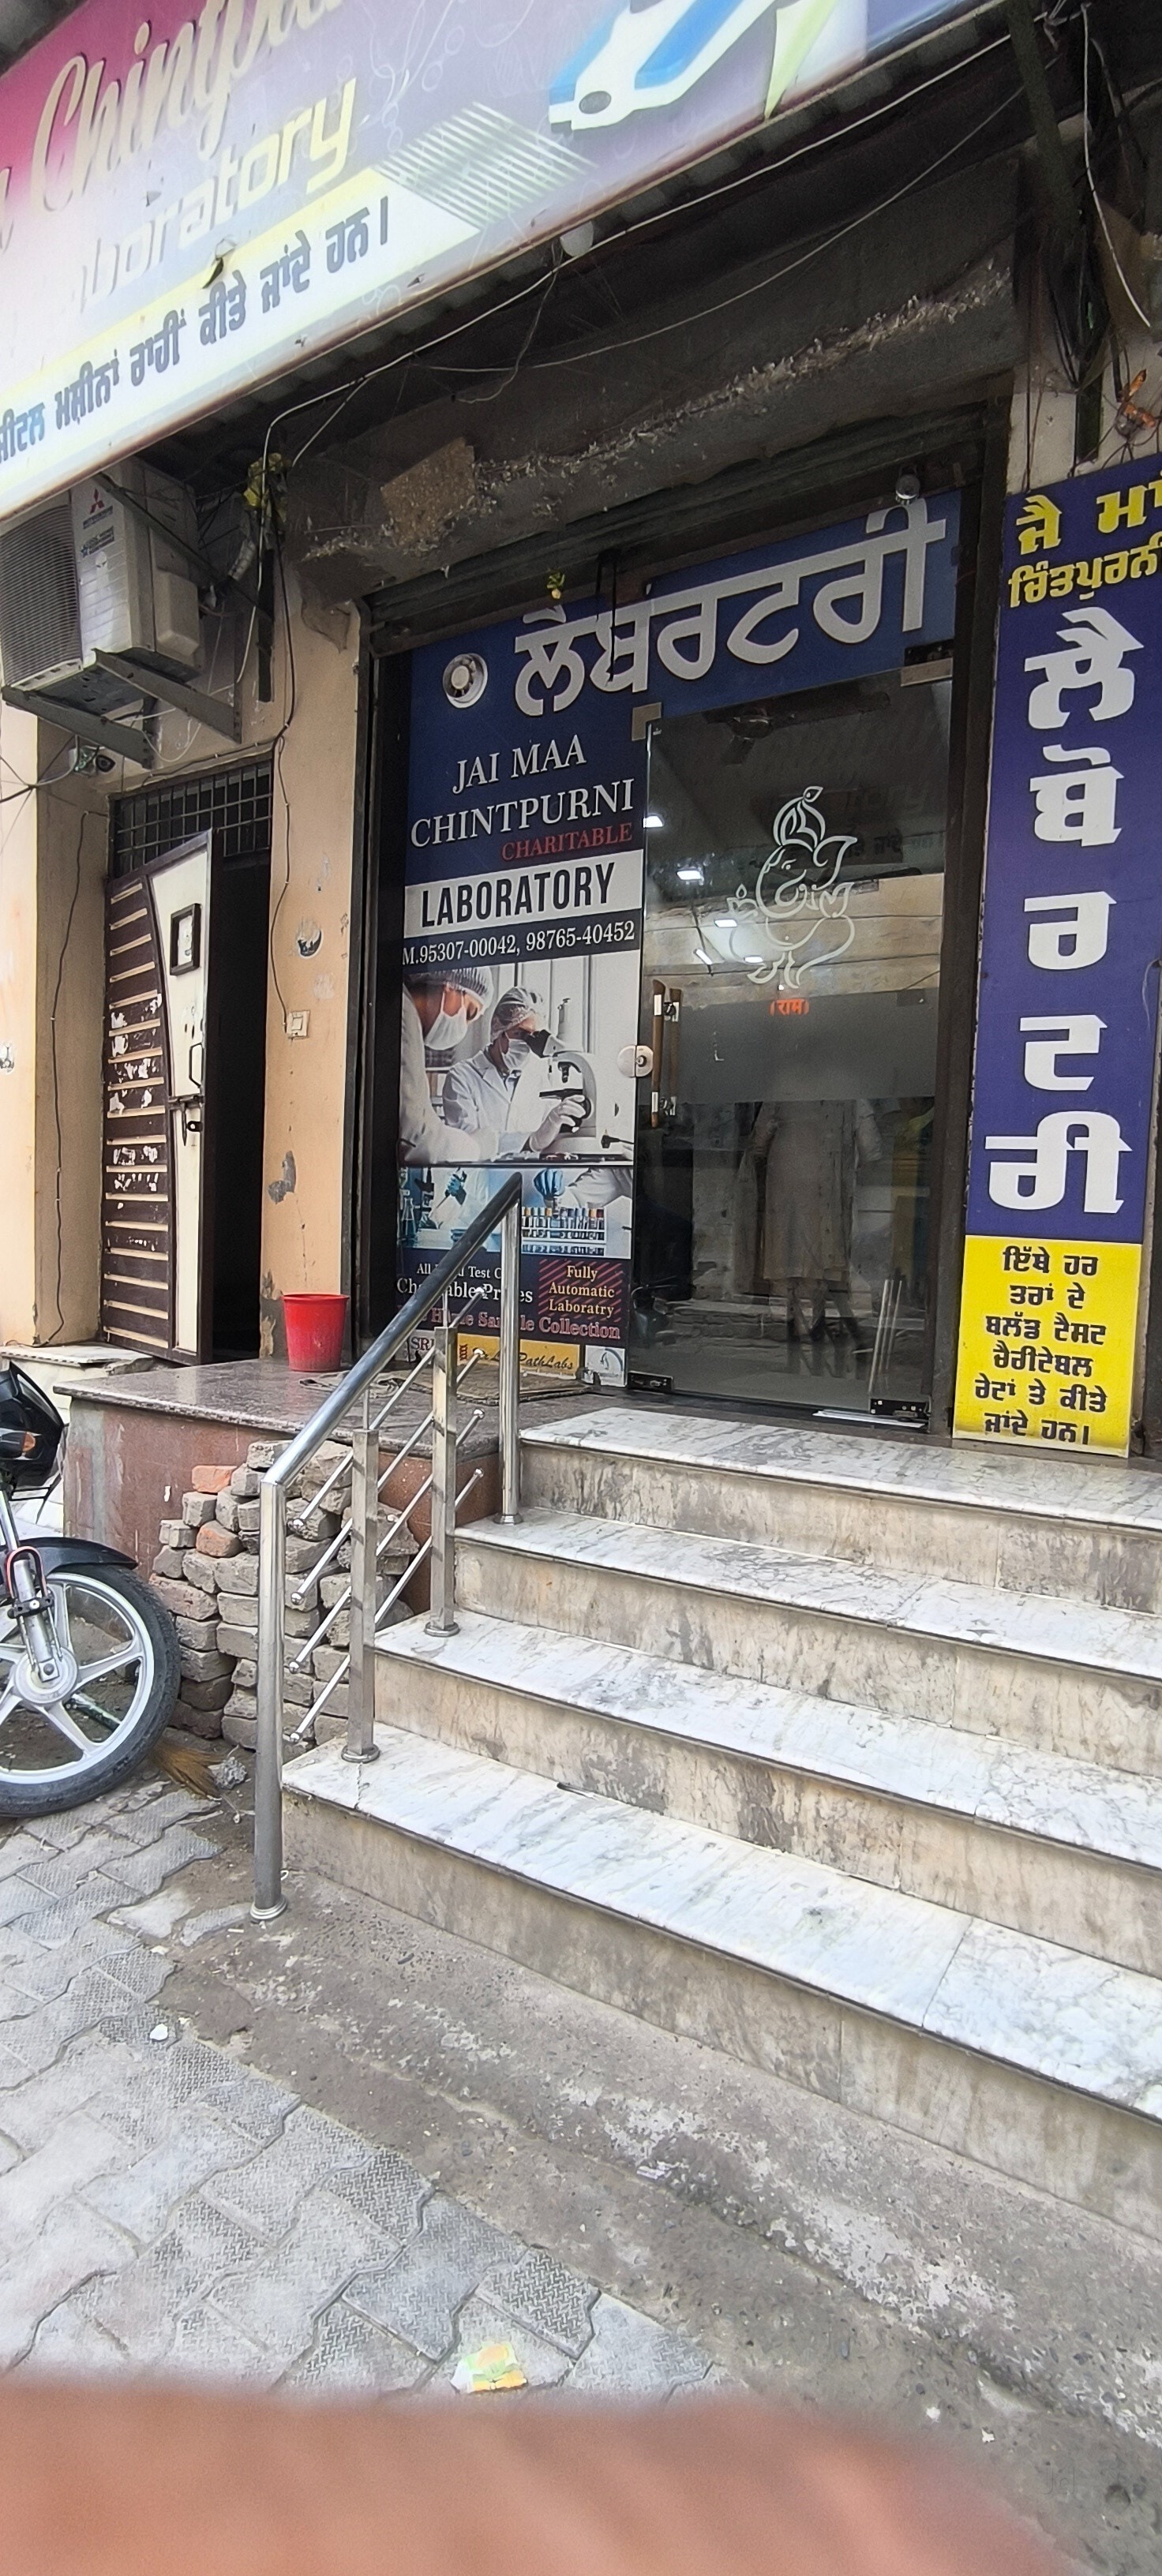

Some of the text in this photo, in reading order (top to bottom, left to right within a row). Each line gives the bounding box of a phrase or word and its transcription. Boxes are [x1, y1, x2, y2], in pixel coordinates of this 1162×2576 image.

[129, 309, 187, 387] ਰਾਹੀਂ
[198, 269, 247, 346] ਕੀਤੇ
[260, 230, 311, 313] ਜਾਂਦੇ
[1016, 494, 1063, 555] ਜੈ
[452, 734, 587, 795] JAI MAA
[410, 778, 635, 848] CHINTPURNI
[500, 822, 632, 861] CHARITABLE
[422, 862, 615, 928] LABORATORY
[402, 920, 635, 965] M.95307-00042, 98765-40452
[417, 1263, 431, 1275] All
[468, 1266, 491, 1279] Test
[567, 1265, 598, 1282] Fully
[1063, 1255, 1099, 1275] ਹਰ
[396, 1277, 533, 1303] Chable Pres
[549, 1282, 615, 1298] Automatic
[1010, 1282, 1085, 1309] ਤਰਾਂ ਦੇ
[431, 1308, 474, 1327] He
[478, 1311, 534, 1331] Sale
[538, 1316, 620, 1339] Collection
[549, 1298, 614, 1319] Laboratry
[986, 1311, 1107, 1345] ਬਲੱਡ ਟੈਸਟ
[993, 1339, 1094, 1378] ਚੈਰੀਟੇਬਲ
[975, 1372, 1108, 1413] ਰੇਟਾਂ ਤੇ ਕੀਤੇ
[984, 1409, 1029, 1436] ਜਾਂਦੇ
